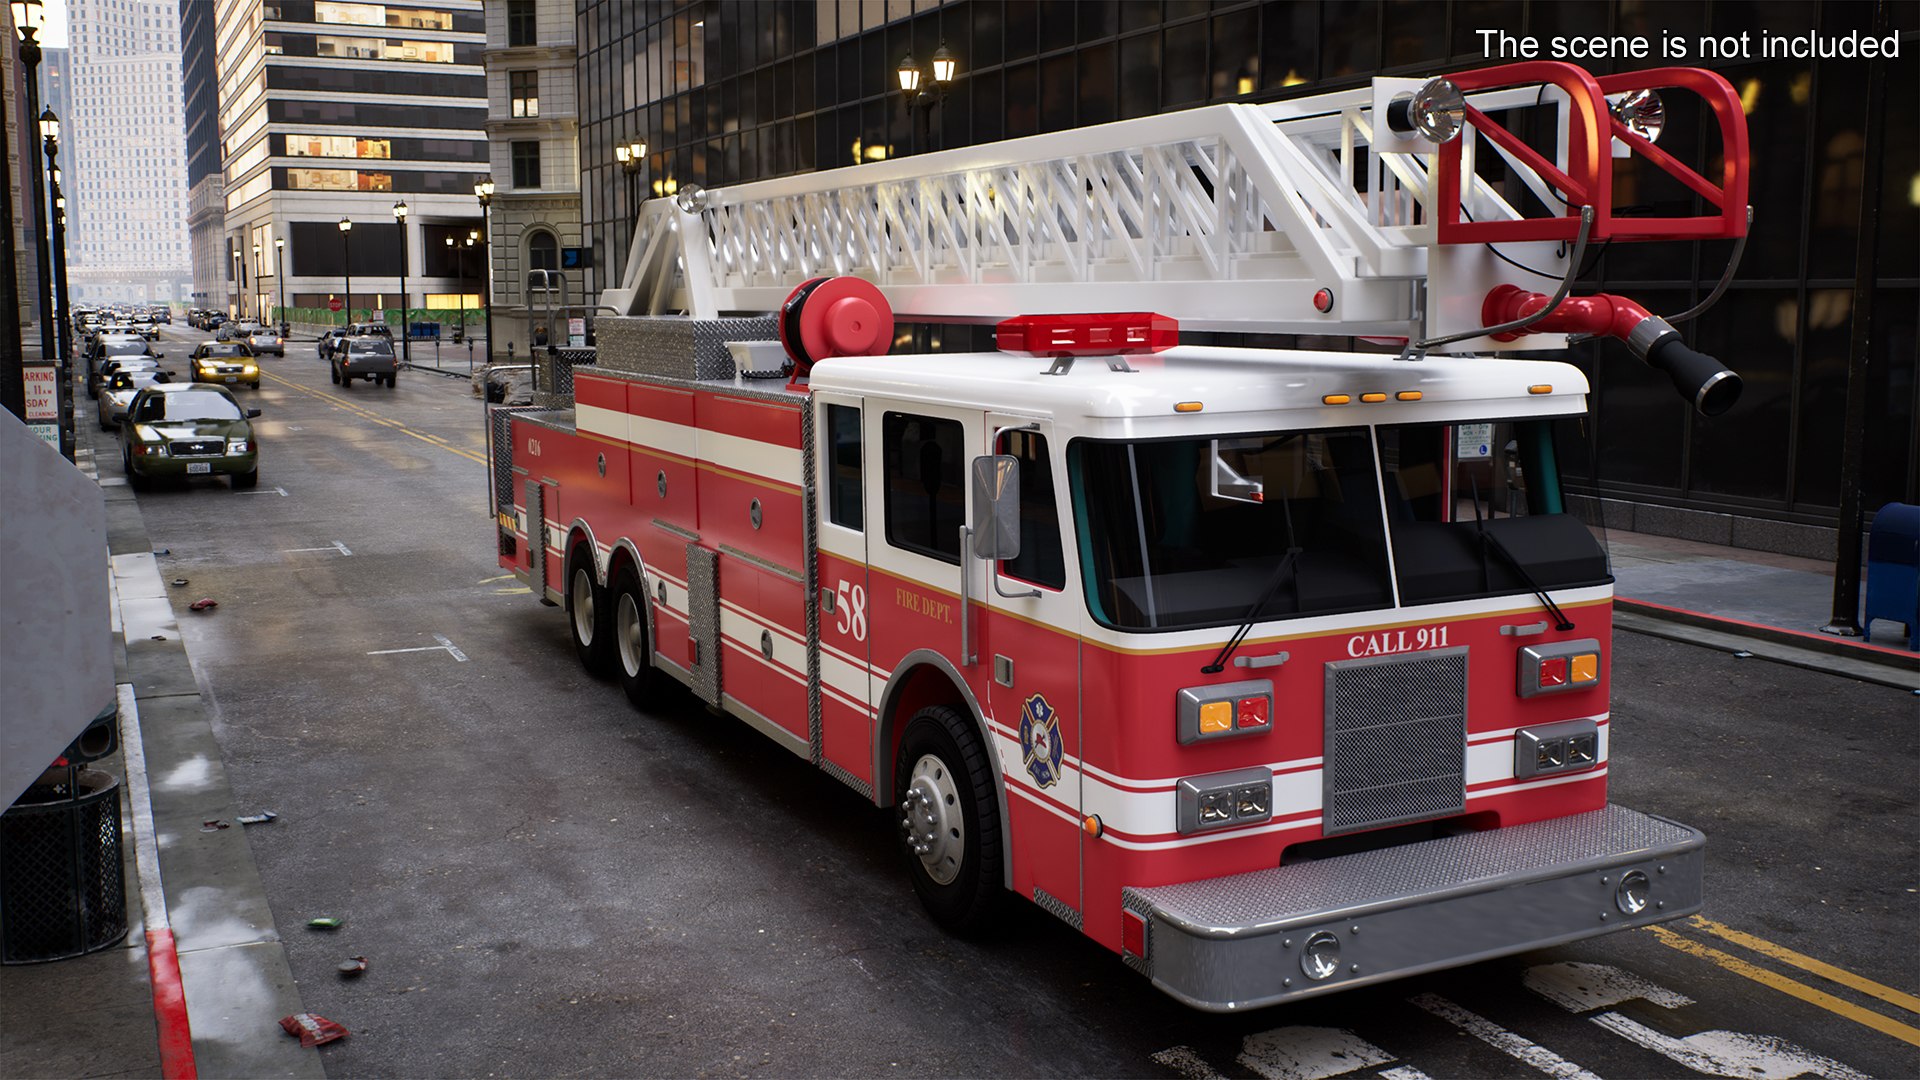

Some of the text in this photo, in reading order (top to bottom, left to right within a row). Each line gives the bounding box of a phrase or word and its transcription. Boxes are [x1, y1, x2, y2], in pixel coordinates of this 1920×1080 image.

[24, 371, 54, 381] ARKING
[26, 399, 48, 407] SDAY
[837, 579, 867, 642] 58
[896, 587, 953, 625] FIRE DEPT.
[1347, 625, 1449, 658] CALL 911
